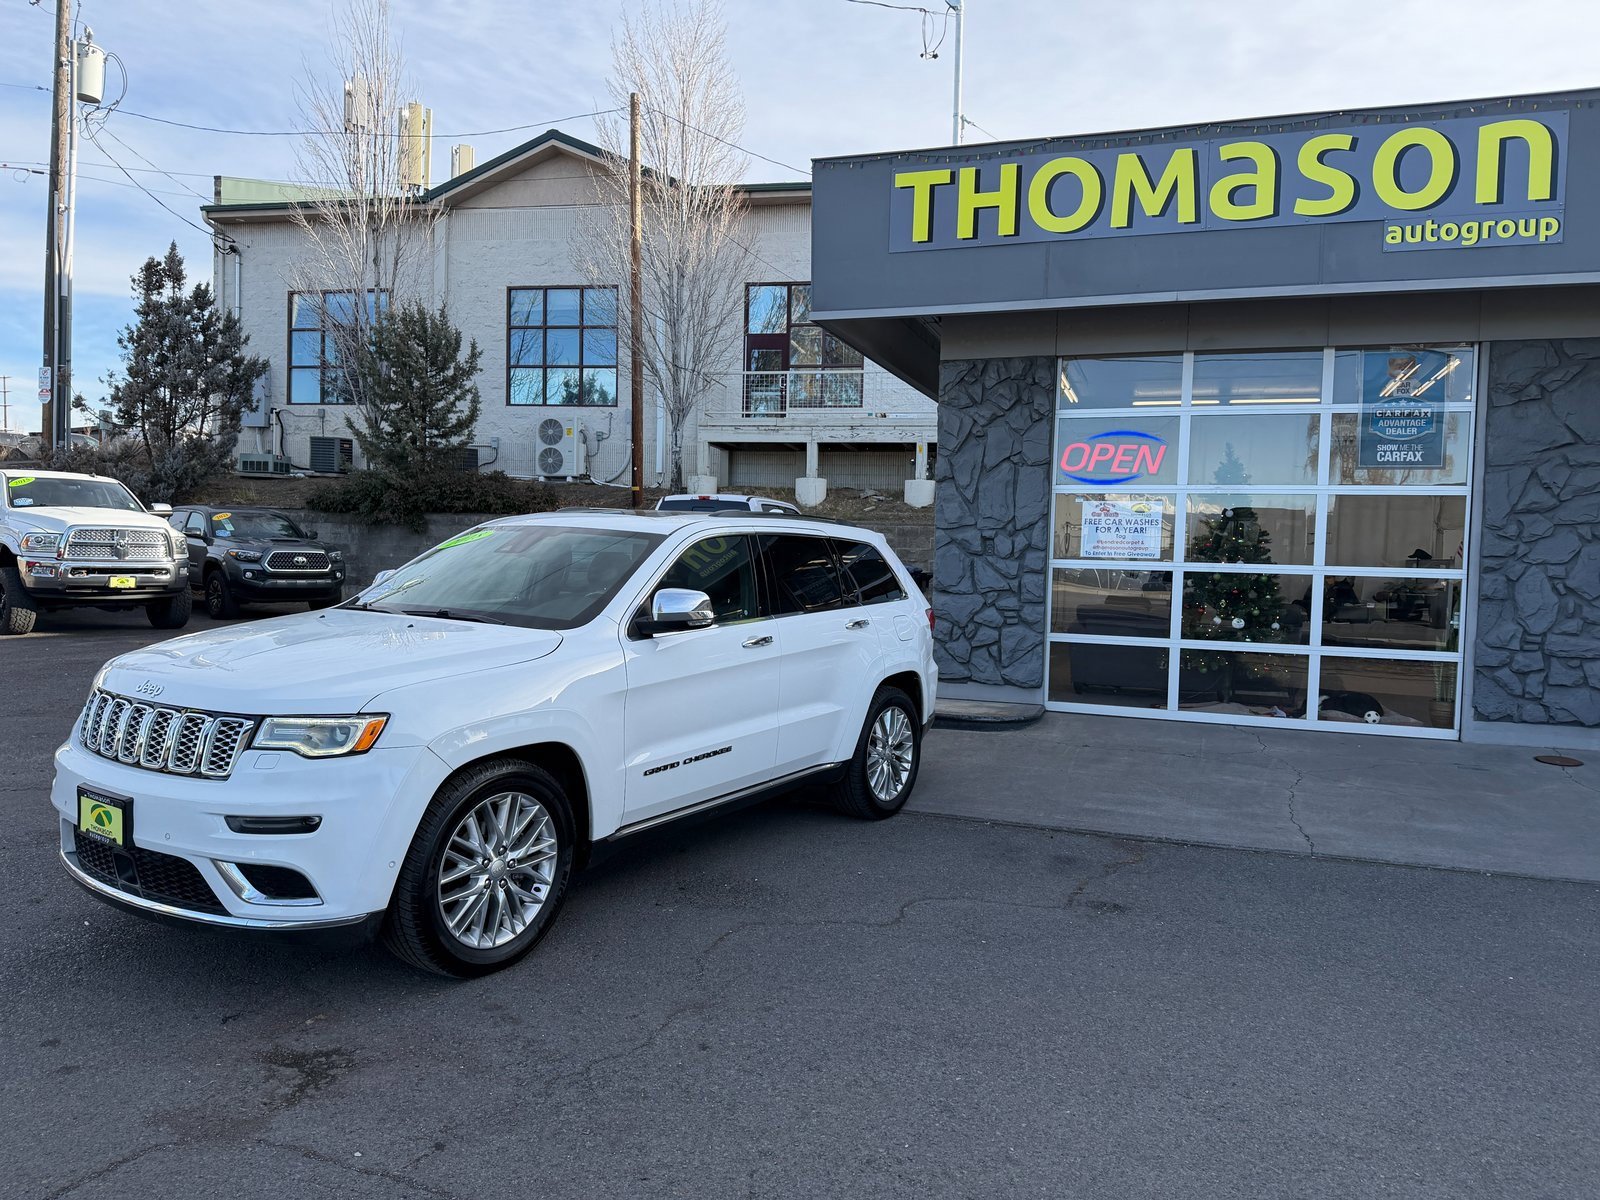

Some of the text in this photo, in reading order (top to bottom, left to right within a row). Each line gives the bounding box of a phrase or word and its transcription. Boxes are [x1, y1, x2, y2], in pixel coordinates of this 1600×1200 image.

[895, 119, 1552, 242] THOMason
[1385, 217, 1559, 245] autogroup
[1376, 409, 1431, 418] CARFAX
[1378, 419, 1427, 427] ADVANTAGE
[1060, 442, 1167, 475] OPEN
[1377, 452, 1423, 462] CARFAX
[1084, 518, 1103, 526] FREE
[1104, 518, 1123, 526] CAR
[1095, 526, 1147, 535] FOR A YEAR!
[135, 680, 164, 698] Jeep
[643, 745, 733, 777] GRAND CHEROKEE
